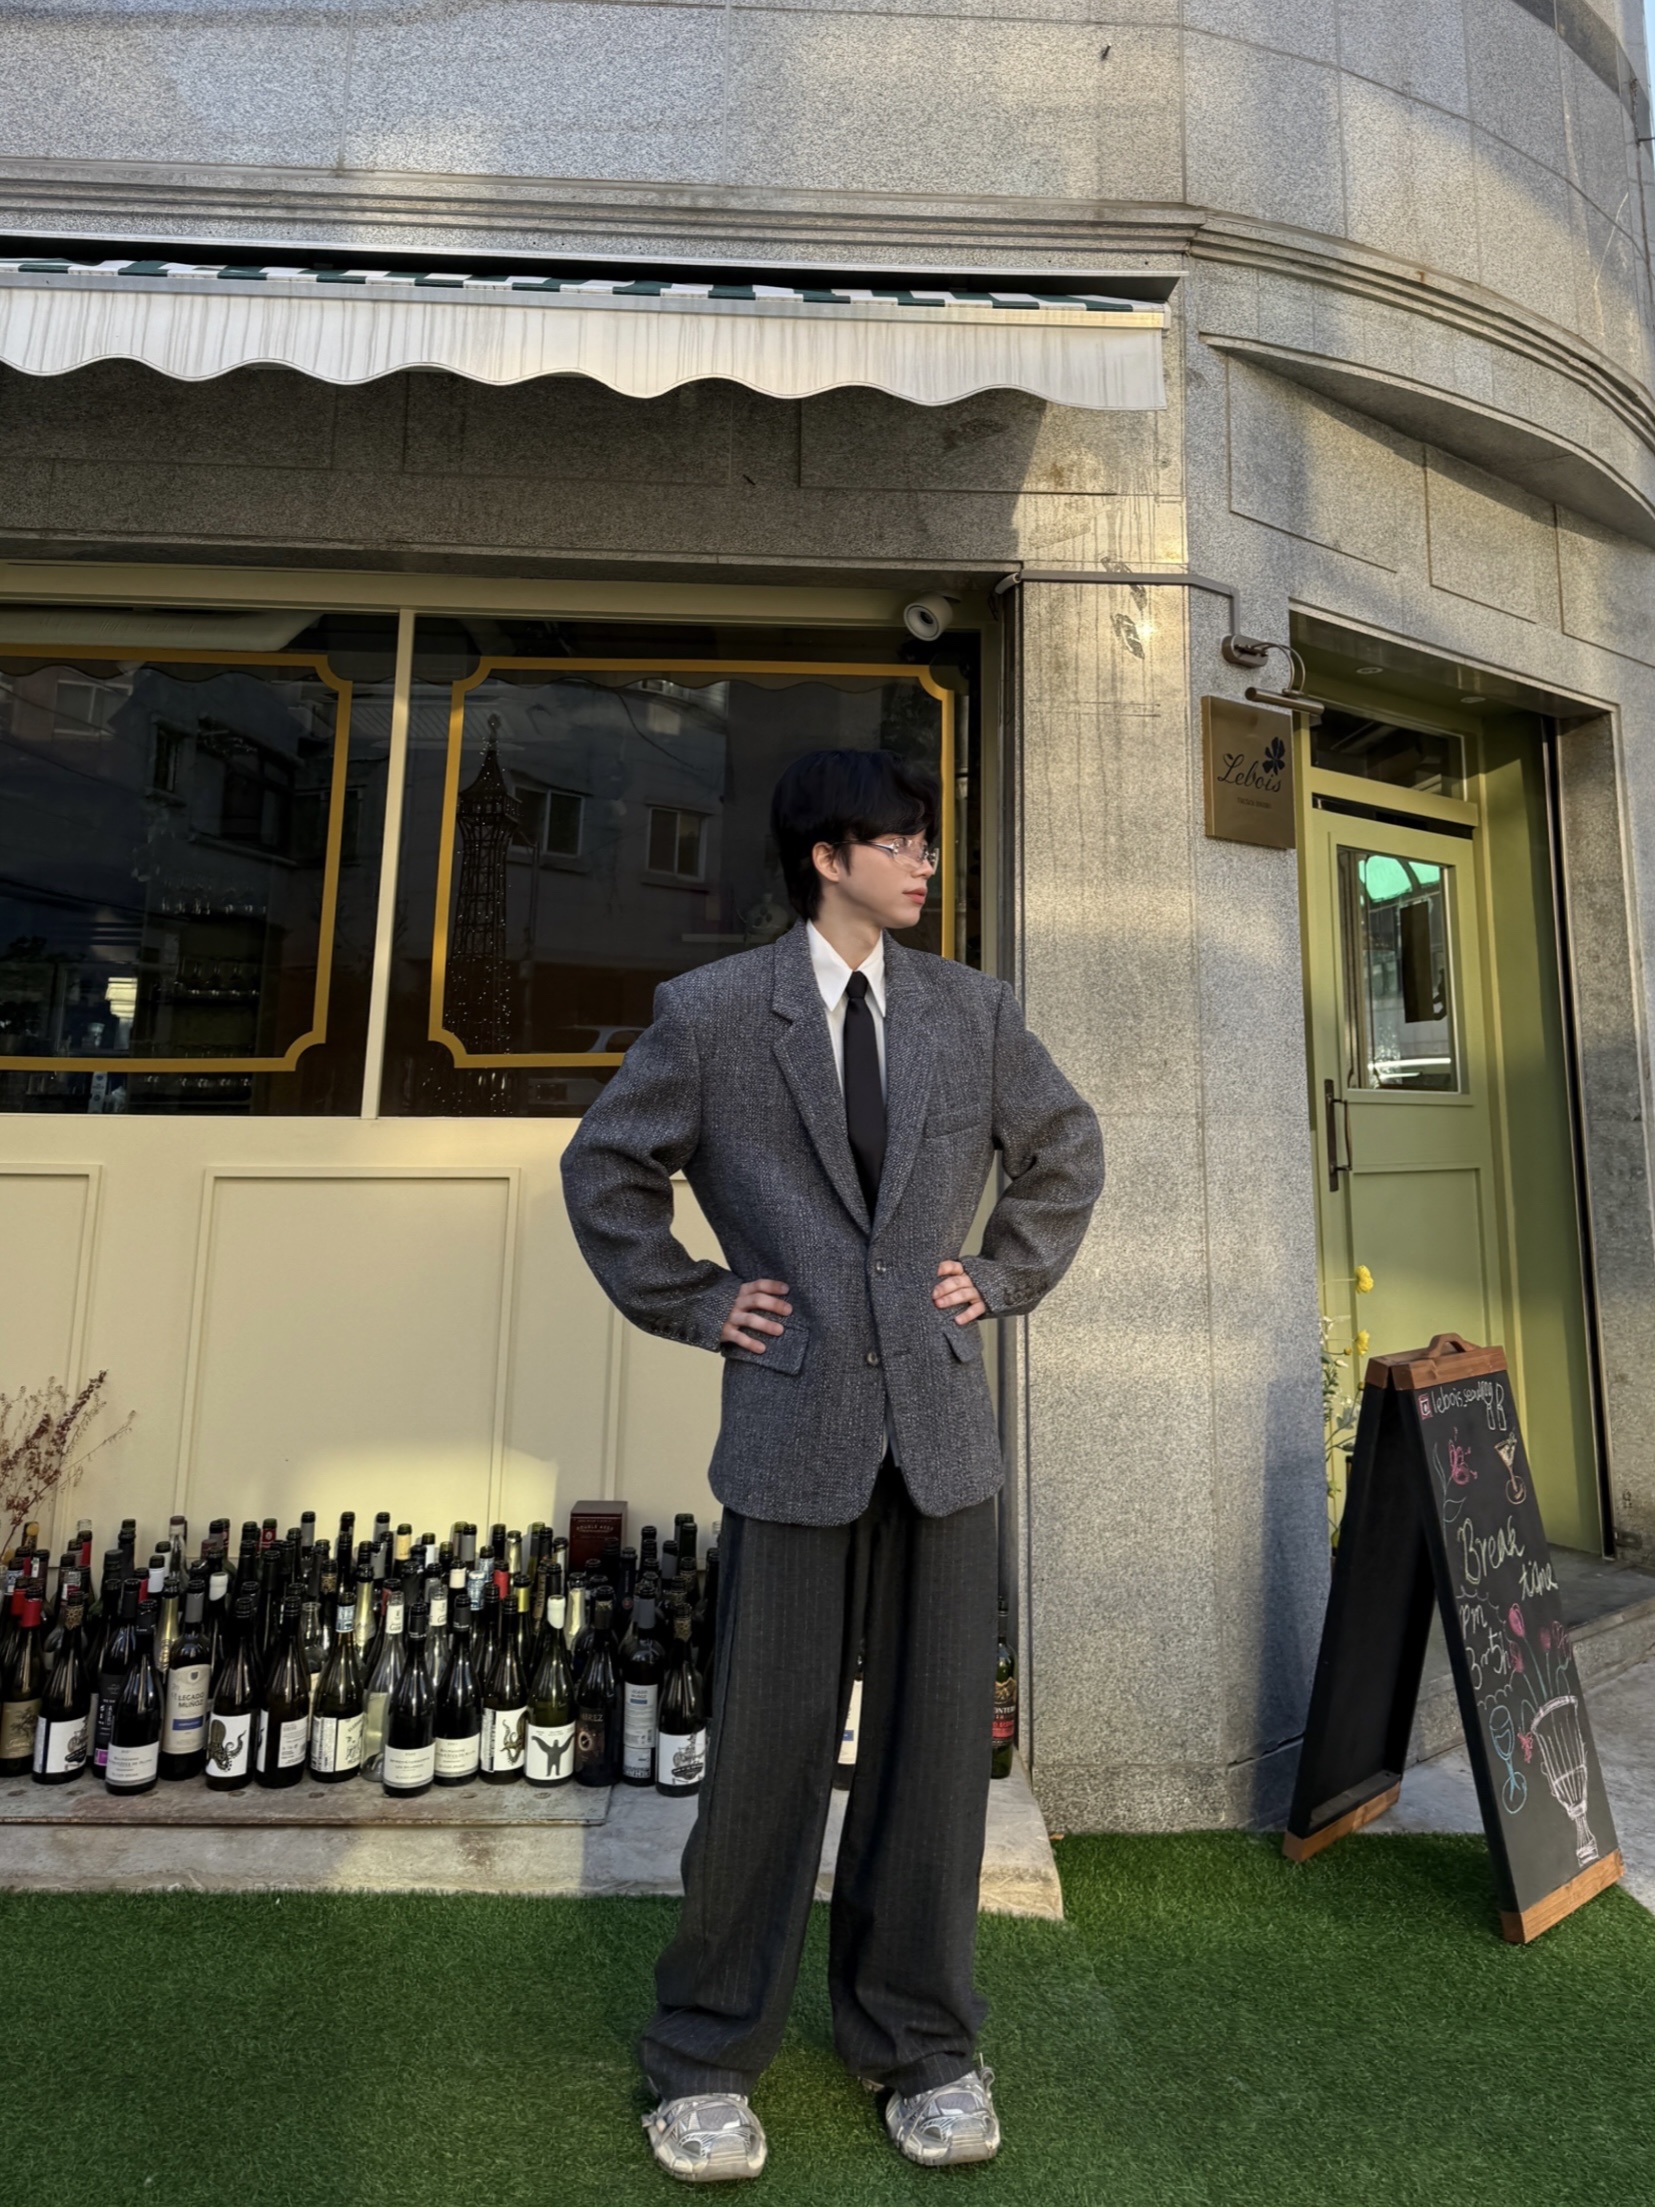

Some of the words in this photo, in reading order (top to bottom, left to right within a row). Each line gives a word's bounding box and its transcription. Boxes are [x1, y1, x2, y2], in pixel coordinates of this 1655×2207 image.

[1217, 753, 1282, 793] Lebois
[1457, 1515, 1525, 1585] Break
[1518, 1561, 1558, 1600] time
[1460, 1603, 1487, 1640] pm
